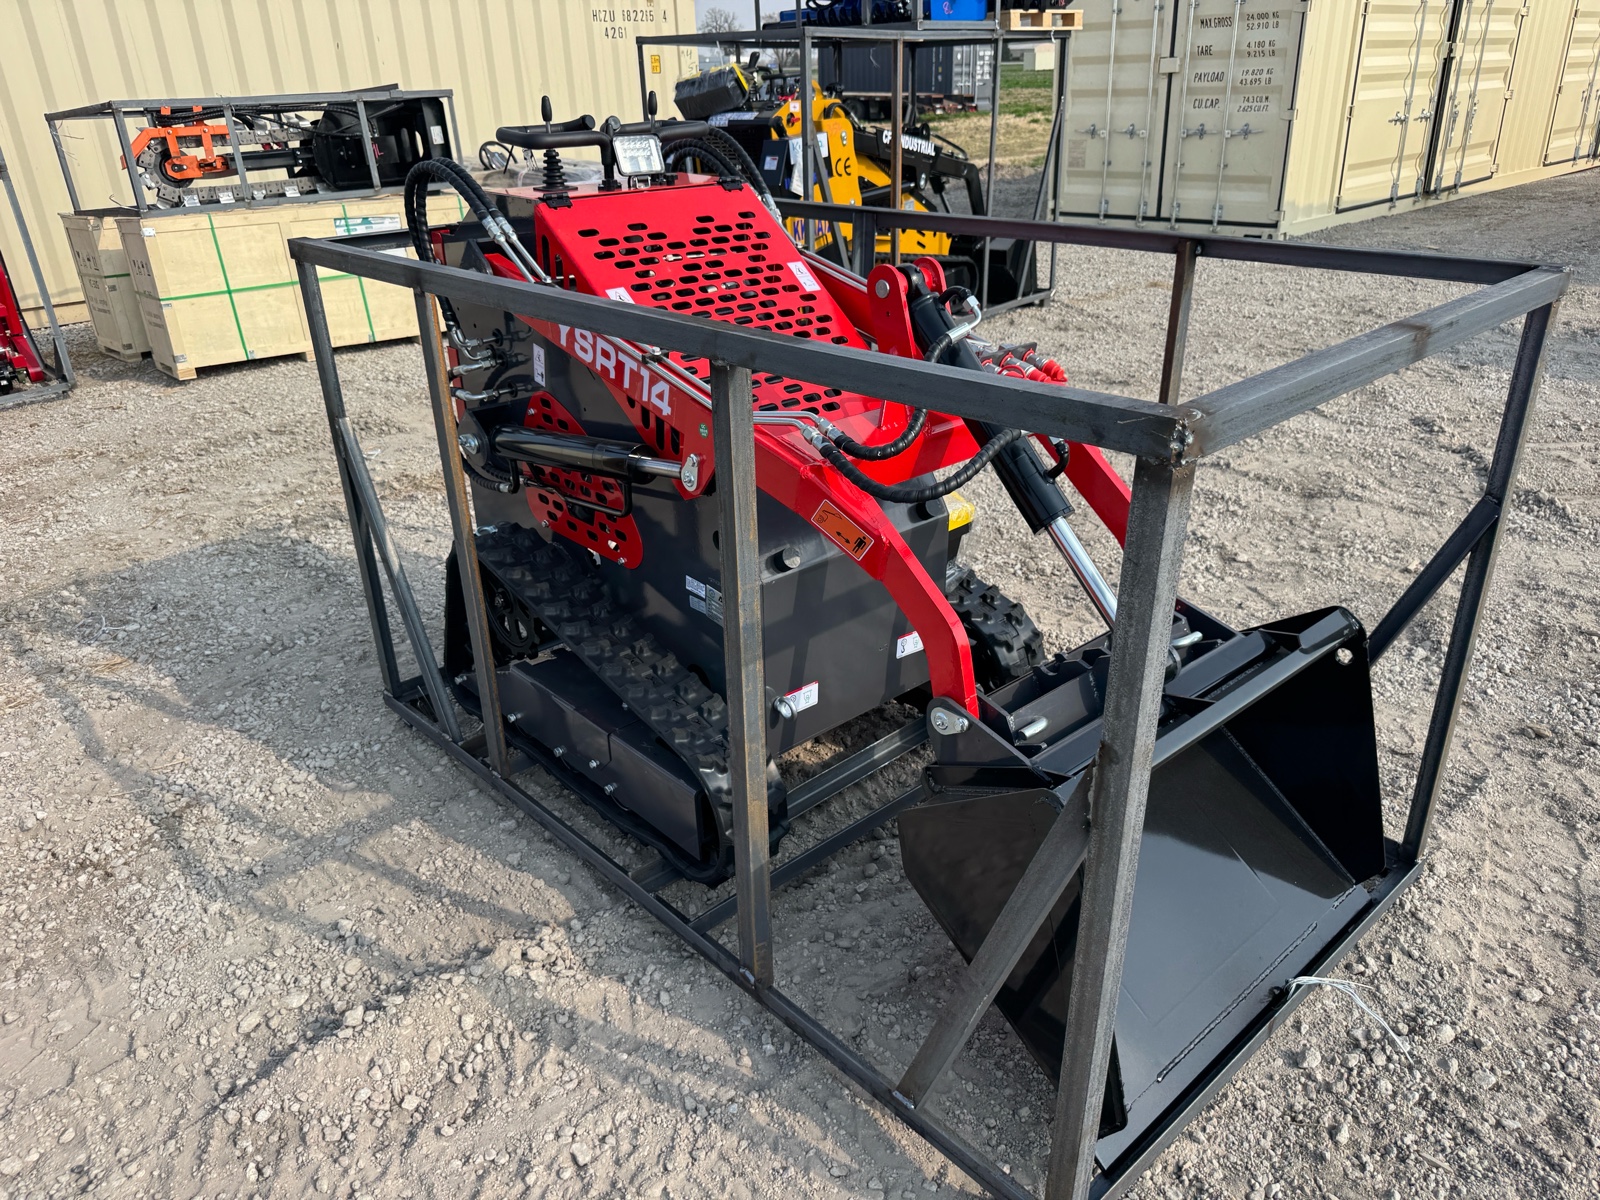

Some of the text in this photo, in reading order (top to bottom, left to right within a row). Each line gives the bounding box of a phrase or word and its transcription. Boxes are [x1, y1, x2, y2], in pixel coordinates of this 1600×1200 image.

[592, 10, 615, 22] HCZU
[622, 10, 654, 22] 682265
[1246, 12, 1269, 20] 24.000
[1246, 22, 1269, 30] 52.910
[605, 27, 627, 39] 42G1
[1197, 45, 1213, 56] TARE
[1194, 72, 1224, 83] PAYLOAD
[901, 134, 936, 156] NDUSTRIAL
[835, 157, 851, 177] CE
[558, 324, 671, 416] YSRT14
